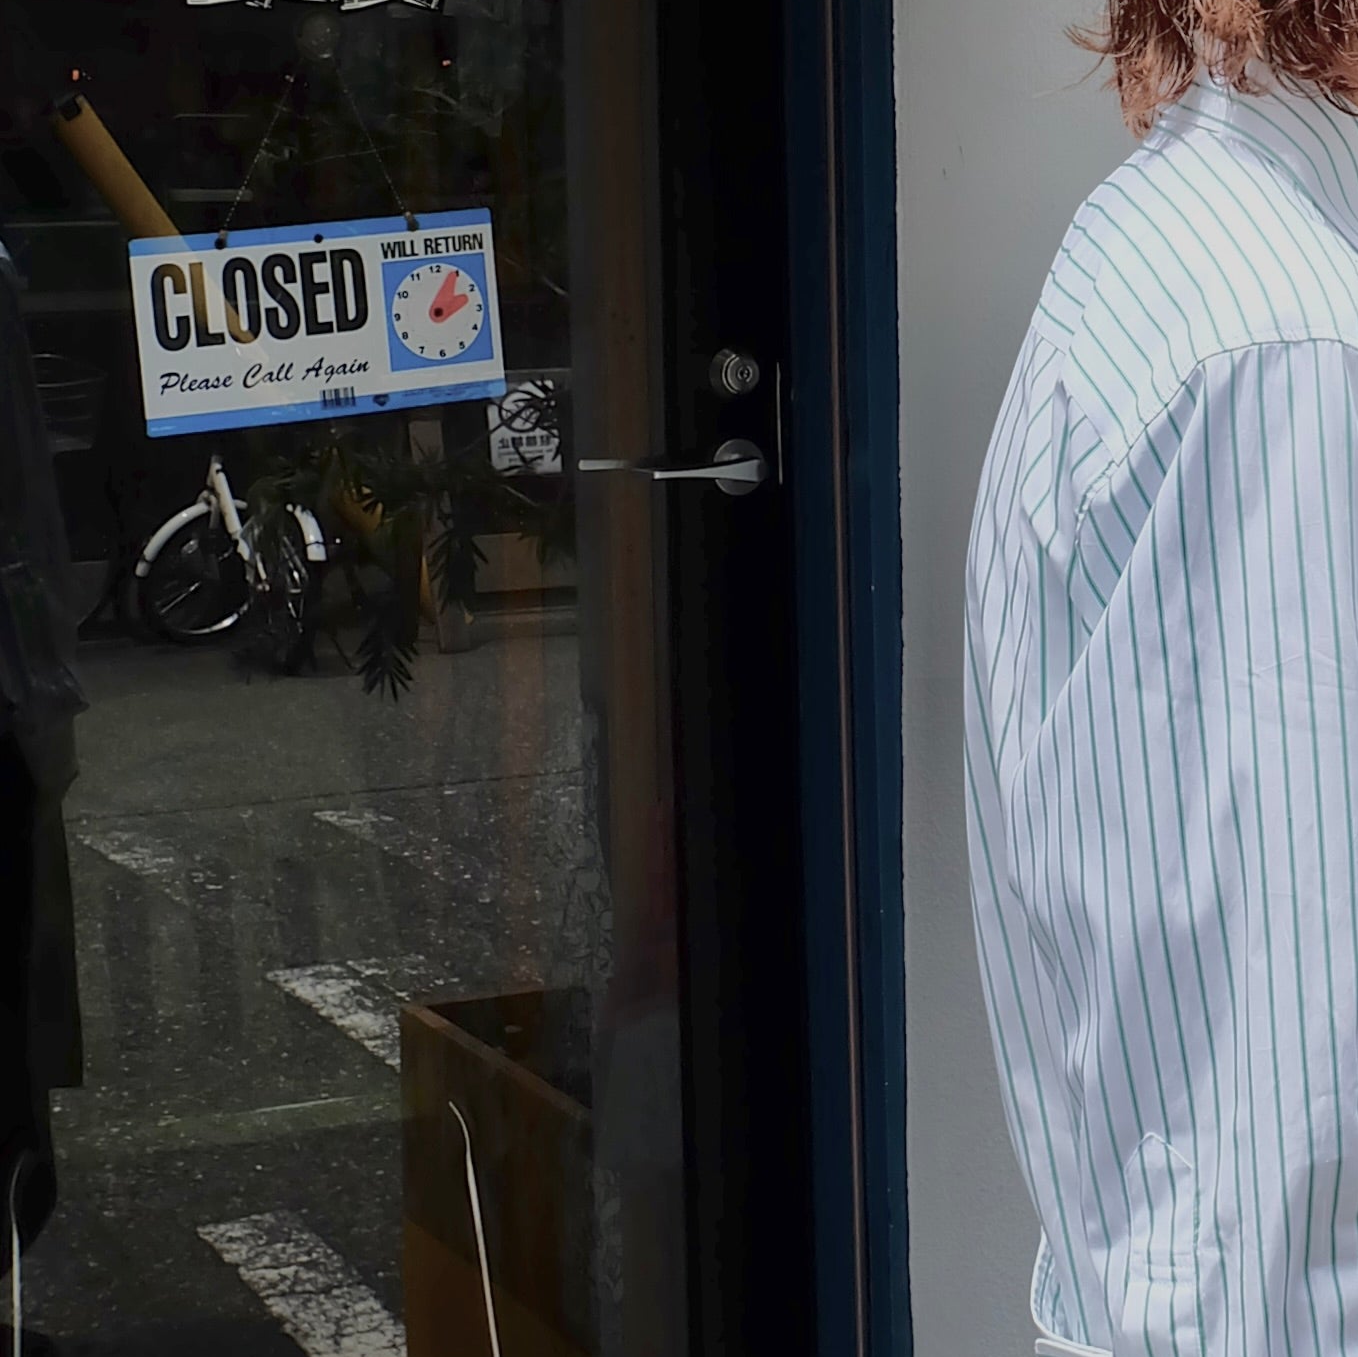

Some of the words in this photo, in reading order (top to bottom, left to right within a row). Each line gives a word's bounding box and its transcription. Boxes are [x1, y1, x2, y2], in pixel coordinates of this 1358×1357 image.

[380, 239, 420, 260] WILL
[423, 232, 485, 256] RETURN
[429, 265, 442, 274] 12
[410, 273, 421, 281] 11
[468, 284, 476, 292] 2
[397, 290, 409, 299] 10
[150, 247, 369, 352] CLOSED
[475, 304, 483, 312] 3
[394, 313, 401, 321] 9
[471, 323, 478, 331] 4
[402, 331, 409, 340] 8
[459, 341, 466, 349] 5
[418, 345, 425, 354] 7
[439, 350, 446, 358] 6
[159, 371, 234, 396] Please
[242, 362, 294, 389] Call
[301, 356, 370, 384] Again
